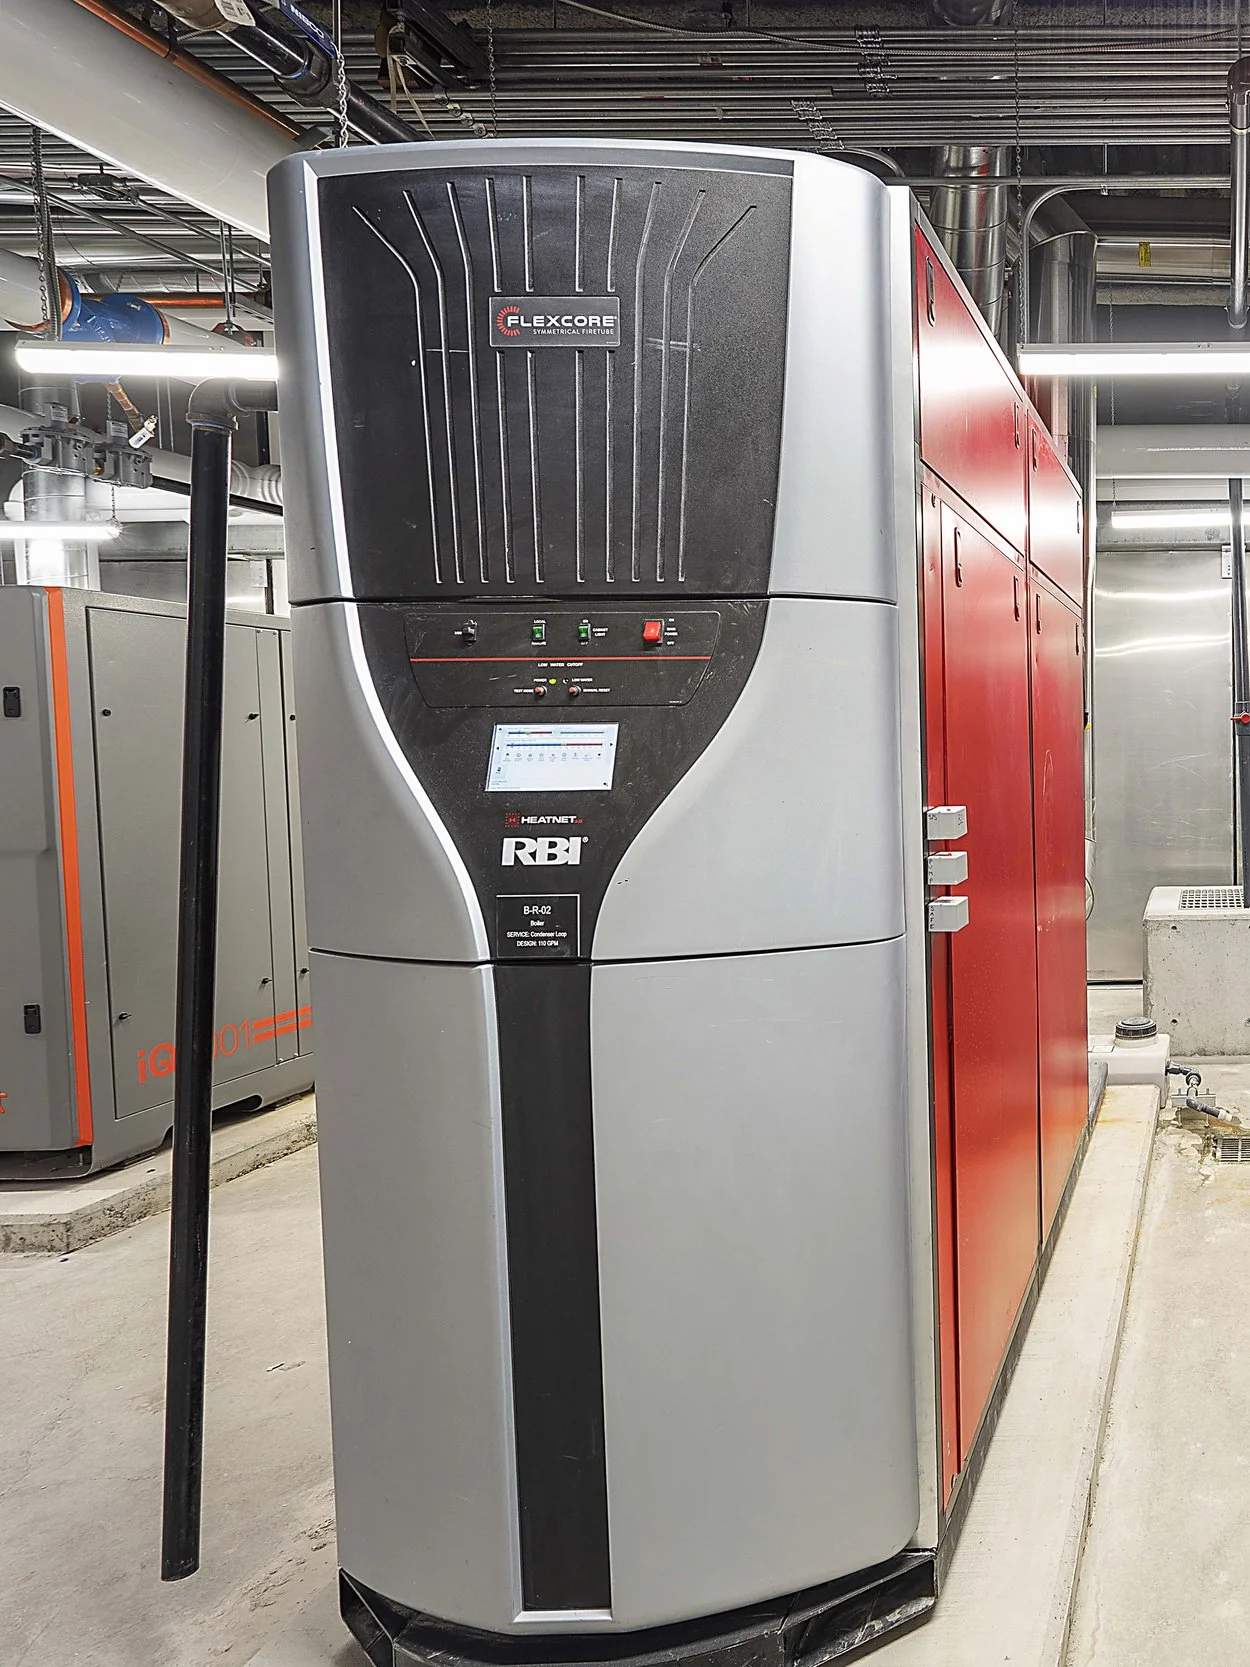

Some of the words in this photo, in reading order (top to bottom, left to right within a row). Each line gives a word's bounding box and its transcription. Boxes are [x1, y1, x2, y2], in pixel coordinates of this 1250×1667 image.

[290, 4, 324, 38] NIBCO
[521, 815, 577, 824] HEATNET
[523, 905, 552, 915] B-R-02
